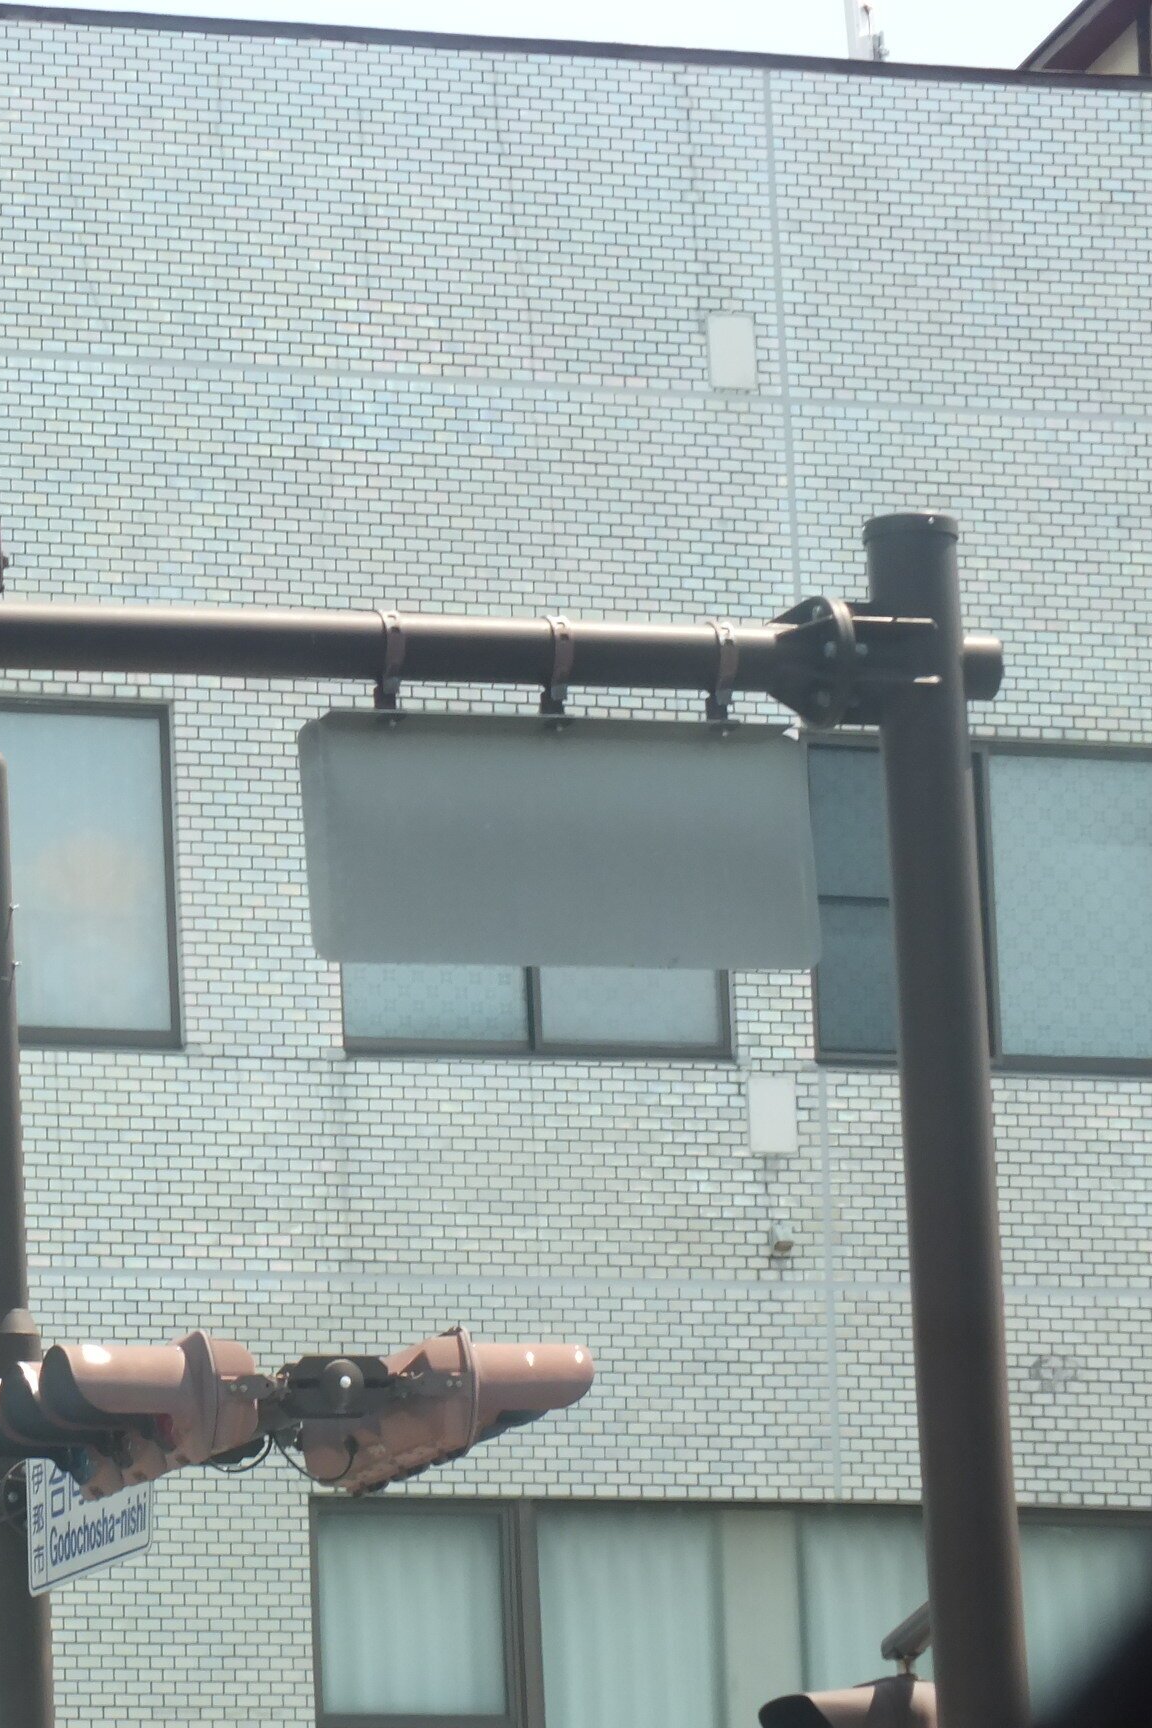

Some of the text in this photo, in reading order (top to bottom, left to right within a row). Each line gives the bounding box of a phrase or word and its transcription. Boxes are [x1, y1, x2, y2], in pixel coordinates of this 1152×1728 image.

[32, 1463, 45, 1574] 伊那市
[50, 1491, 147, 1566] Godochosha-nishi
